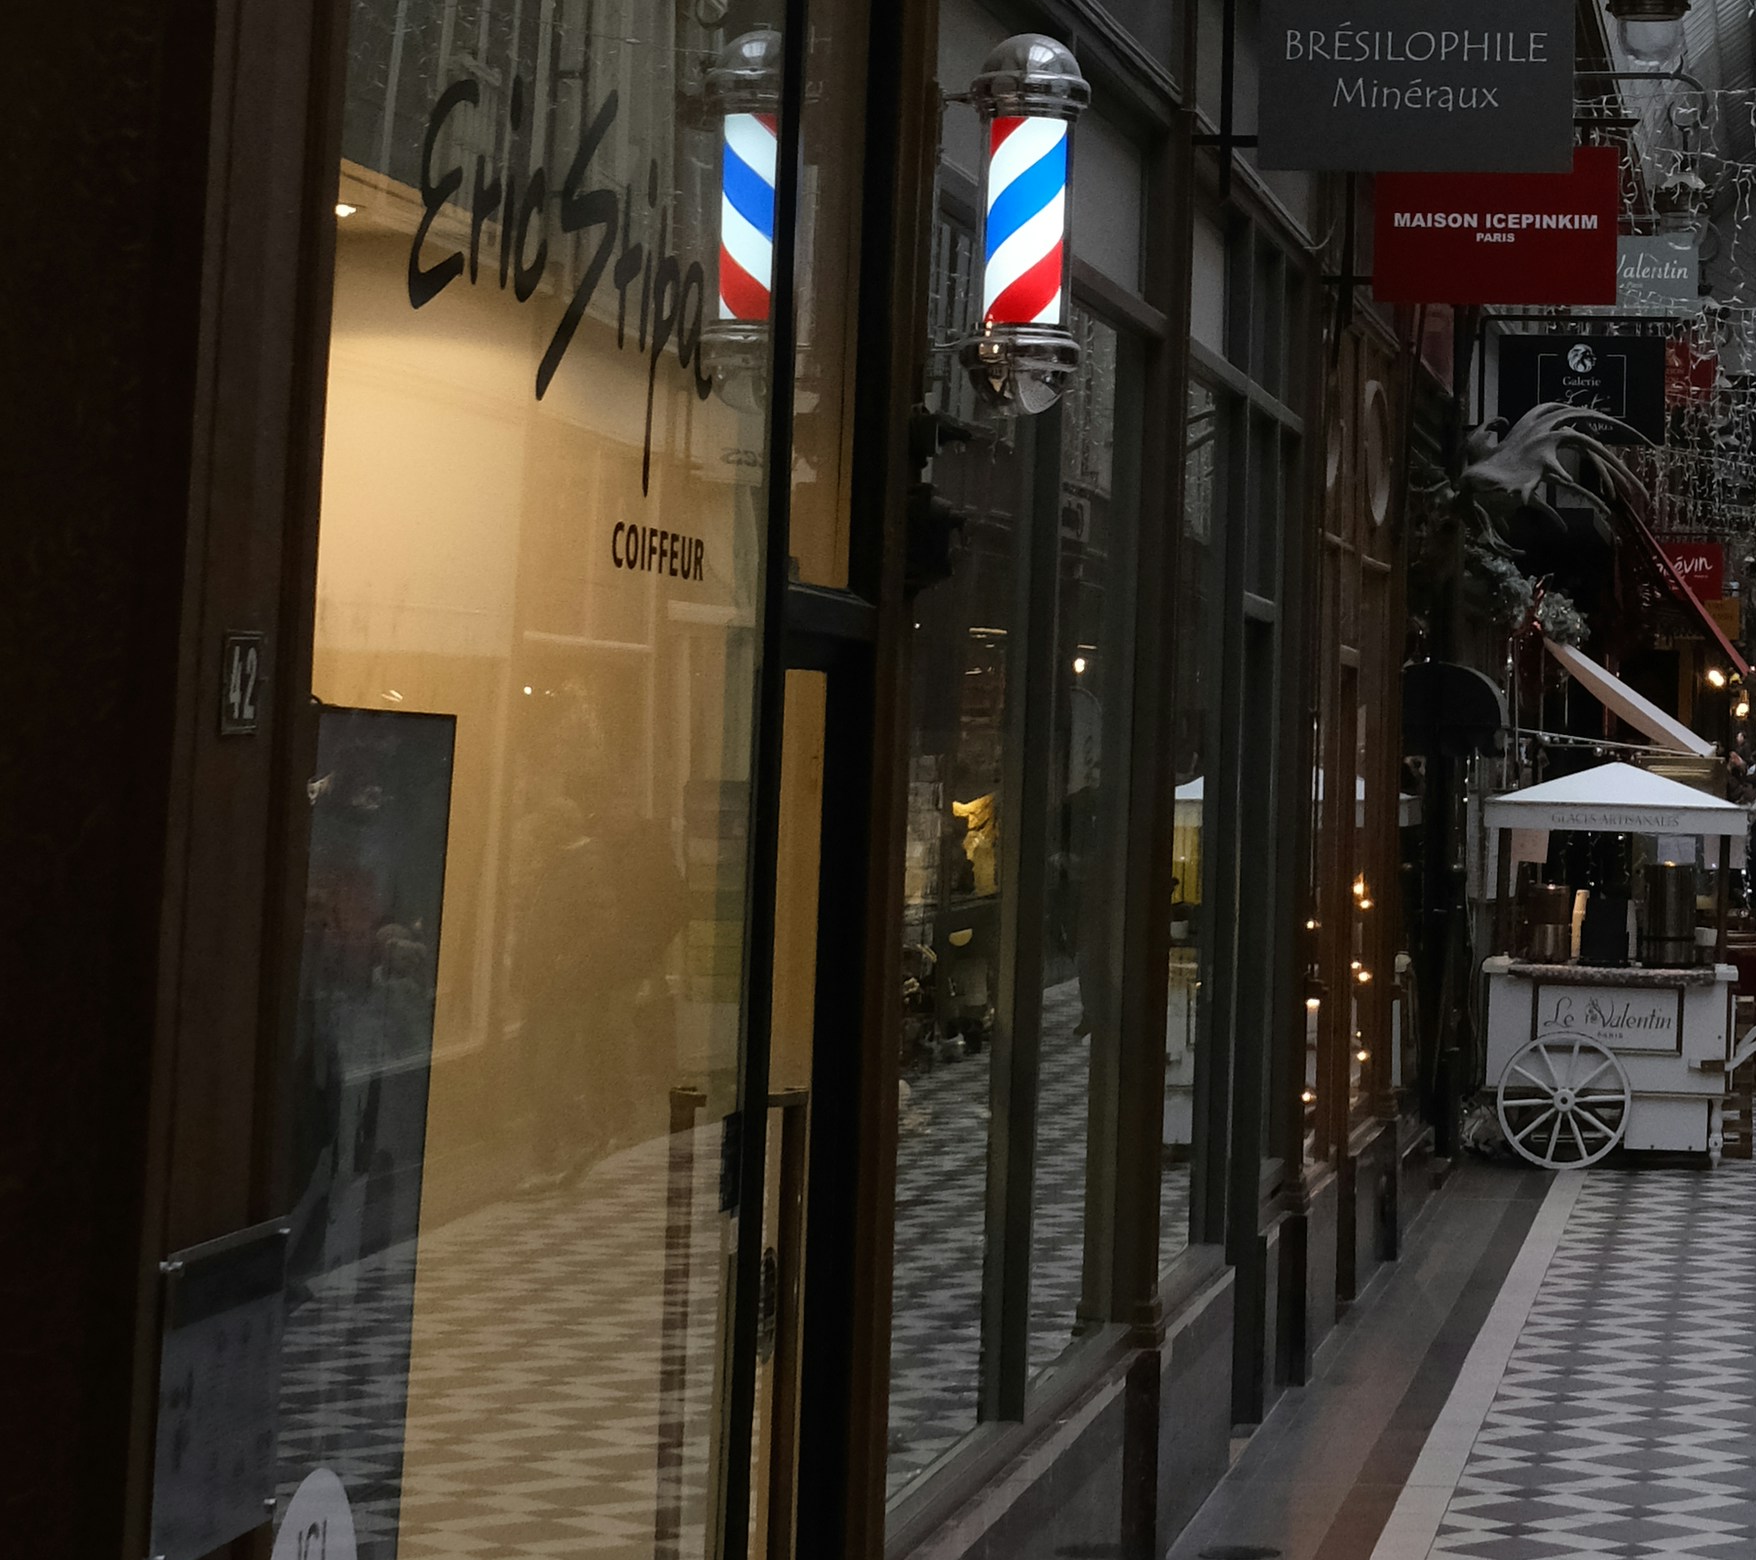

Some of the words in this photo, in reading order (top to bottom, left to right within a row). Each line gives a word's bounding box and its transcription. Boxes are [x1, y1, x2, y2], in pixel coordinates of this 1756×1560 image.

[1285, 21, 1549, 63] BRÉSILOPHILE
[1332, 77, 1500, 112] Minéraux
[1393, 212, 1479, 229] MAISON
[1484, 213, 1598, 230] ICEPINKIM
[1476, 232, 1515, 244] PARIS
[408, 75, 548, 310] Eric
[536, 89, 713, 498] Stipa
[1562, 376, 1602, 387] Galerie
[612, 521, 704, 580] COIFFEUR
[229, 645, 257, 720] 42
[1543, 996, 1576, 1029] Le
[1591, 999, 1672, 1030] Valentin
